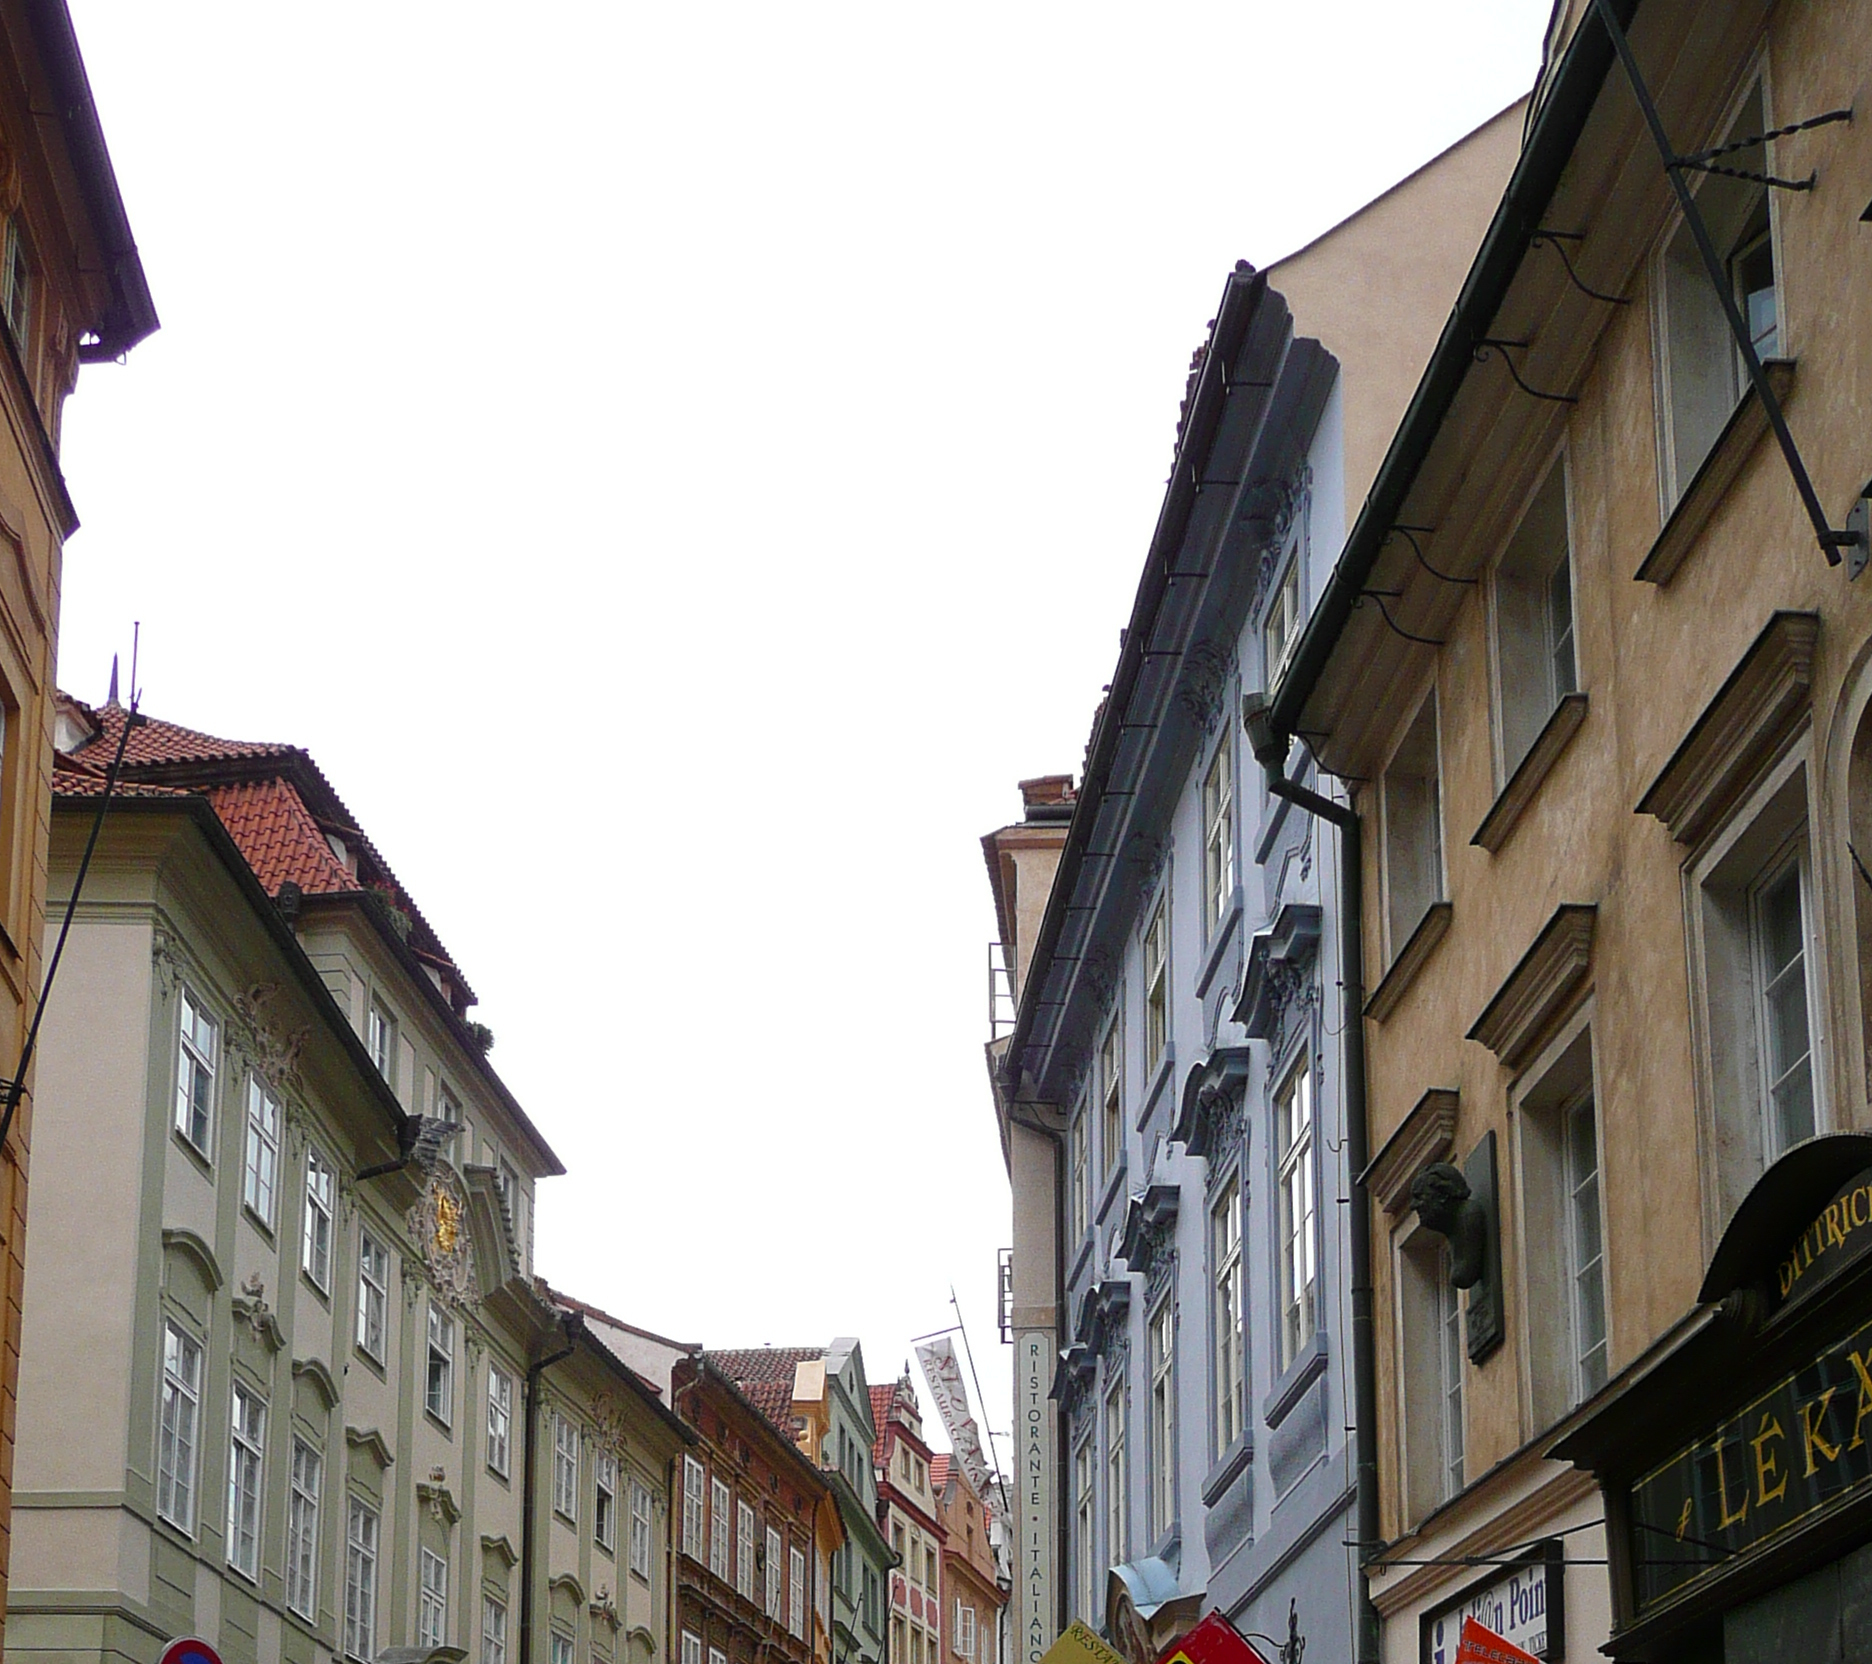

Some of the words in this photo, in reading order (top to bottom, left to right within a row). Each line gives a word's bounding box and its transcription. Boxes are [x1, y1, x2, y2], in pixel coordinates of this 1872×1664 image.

[1776, 1182, 1872, 1299] DITTRIC
[1027, 1343, 1041, 1506] RISTORANTE
[1029, 1532, 1043, 1664] ITALIANO
